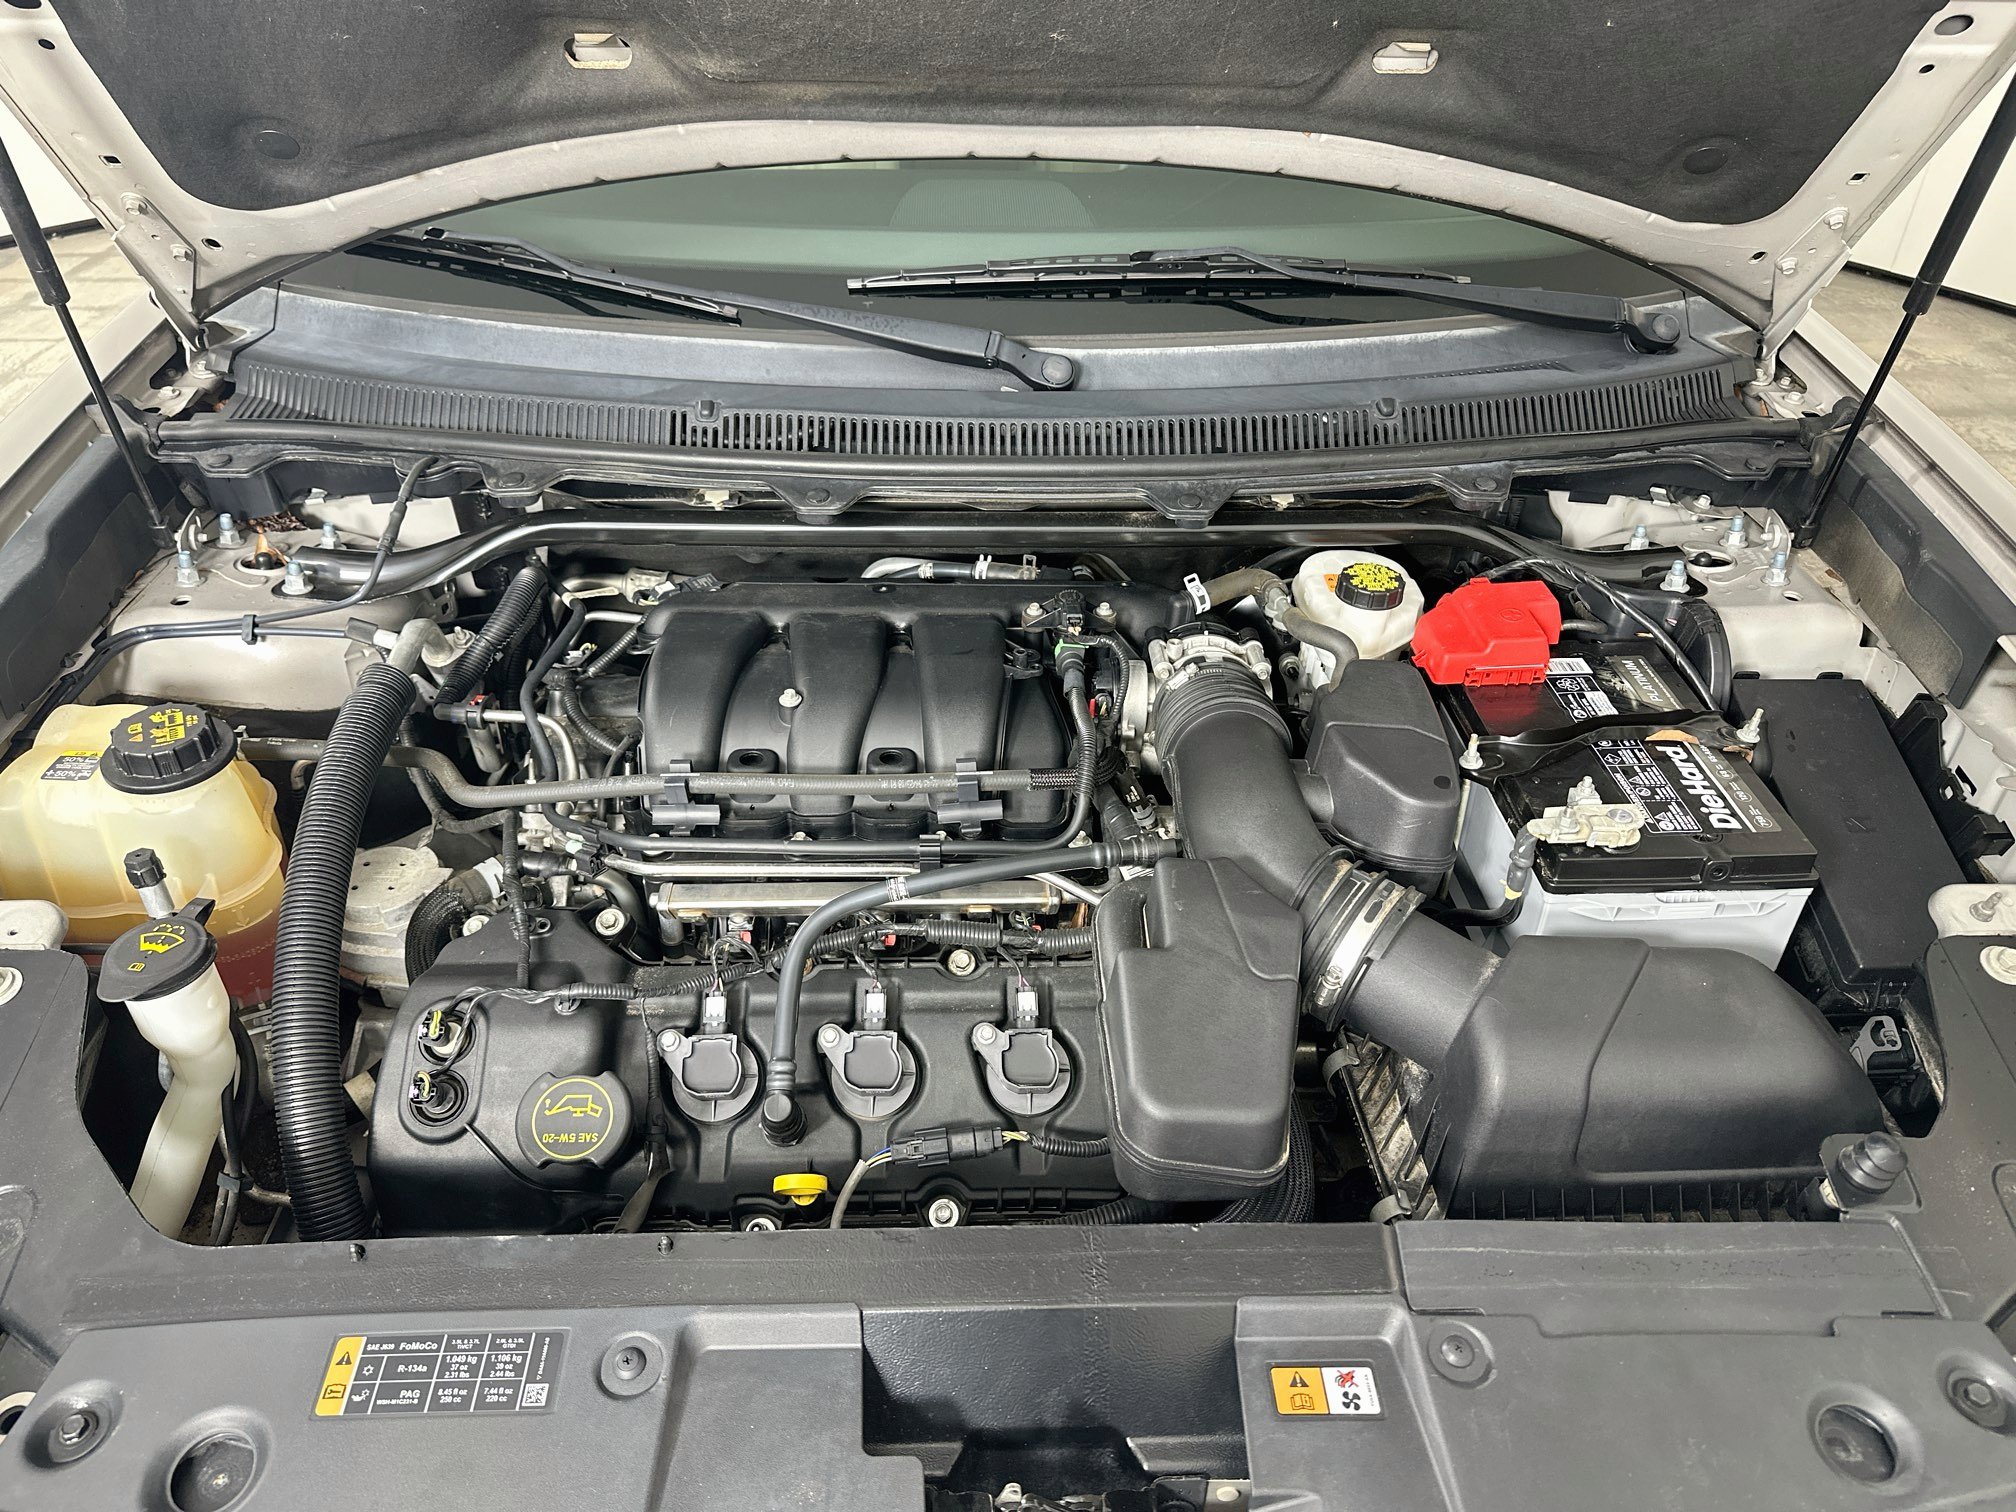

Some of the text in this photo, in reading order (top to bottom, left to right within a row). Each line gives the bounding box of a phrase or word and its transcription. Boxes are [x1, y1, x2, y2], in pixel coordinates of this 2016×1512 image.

[1622, 660, 1663, 702] PLATINUM
[1655, 745, 1743, 829] DieHard
[542, 1133, 598, 1143] SAE 5W-20
[366, 1343, 380, 1351] SAE
[399, 1341, 438, 1351] FoMoCo
[446, 1354, 478, 1365] 1.049 kg
[491, 1353, 523, 1364] 1.106 kg
[397, 1364, 428, 1373] R-134a
[450, 1363, 460, 1371] 37
[444, 1371, 458, 1379] 2.31
[400, 1389, 421, 1399] PAG
[485, 1394, 499, 1402] 220
